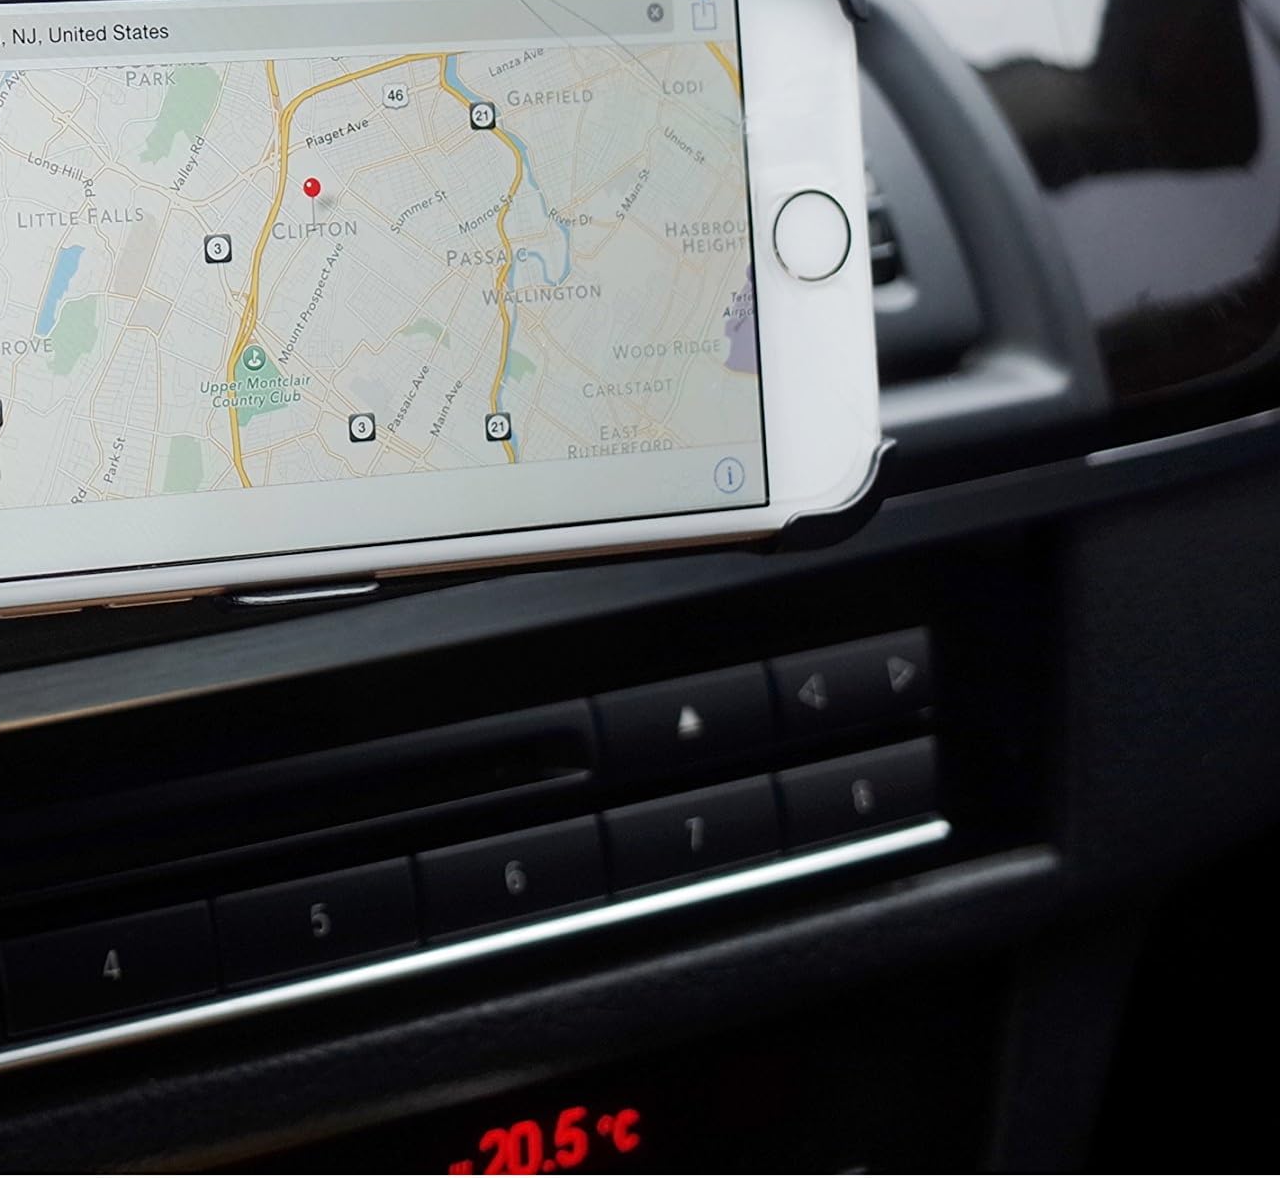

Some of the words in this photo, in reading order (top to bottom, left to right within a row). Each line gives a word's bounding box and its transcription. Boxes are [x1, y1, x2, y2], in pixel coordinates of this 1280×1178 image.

[12, 28, 42, 45] NJ,
[48, 25, 107, 43] United
[112, 23, 170, 41] States
[488, 57, 522, 78] Lanza
[523, 47, 545, 64] Ave
[125, 69, 177, 88] PARK
[661, 79, 704, 96] LODI
[387, 89, 404, 102] 46
[506, 89, 593, 107] GARFIELD
[474, 110, 489, 122] 21
[305, 127, 346, 150] Piaget
[346, 118, 370, 135] Ave
[663, 125, 694, 156] Union
[692, 152, 706, 165] St
[27, 151, 61, 176] Long
[60, 164, 84, 183] Hill
[82, 178, 96, 199] Rd
[170, 157, 199, 193] Valley
[190, 135, 206, 157] Rd
[615, 209, 626, 221] S
[621, 182, 644, 212] Main
[642, 168, 651, 183] St
[17, 211, 79, 228] LITTLE
[87, 207, 144, 224] FALLS
[390, 197, 434, 234] Summer
[433, 189, 448, 204] St
[458, 203, 501, 235] Monroe
[548, 207, 575, 227] River
[578, 213, 594, 227] Dr
[272, 221, 357, 240] CLIFTON
[214, 243, 222, 255] 3
[446, 247, 528, 266] PASSAC
[278, 322, 305, 365] Mount
[301, 266, 331, 323] Prospect
[326, 243, 344, 268] Ave
[482, 284, 602, 306] WALLINGTON
[612, 343, 668, 360] WOOD
[673, 339, 721, 356] RIDGE
[200, 380, 242, 396] Upper
[246, 374, 311, 390] Montclair
[582, 378, 672, 399] CARLSTADT
[212, 393, 265, 409] Country
[269, 389, 302, 404] Club
[386, 389, 417, 434] Passaic
[411, 365, 431, 391] Ave
[429, 407, 451, 438] Main
[445, 380, 464, 405] Ave
[358, 422, 367, 434] 3
[490, 422, 505, 433] 21
[599, 425, 640, 441] EAST
[567, 439, 674, 459] RUTHERFORD
[103, 454, 121, 484] Park
[112, 437, 126, 452] St
[70, 486, 88, 504] Rd
[851, 778, 876, 816] 8
[504, 860, 528, 901] 6
[310, 902, 332, 939] 5
[103, 949, 121, 982] 4
[479, 1106, 588, 1175] 20.5
